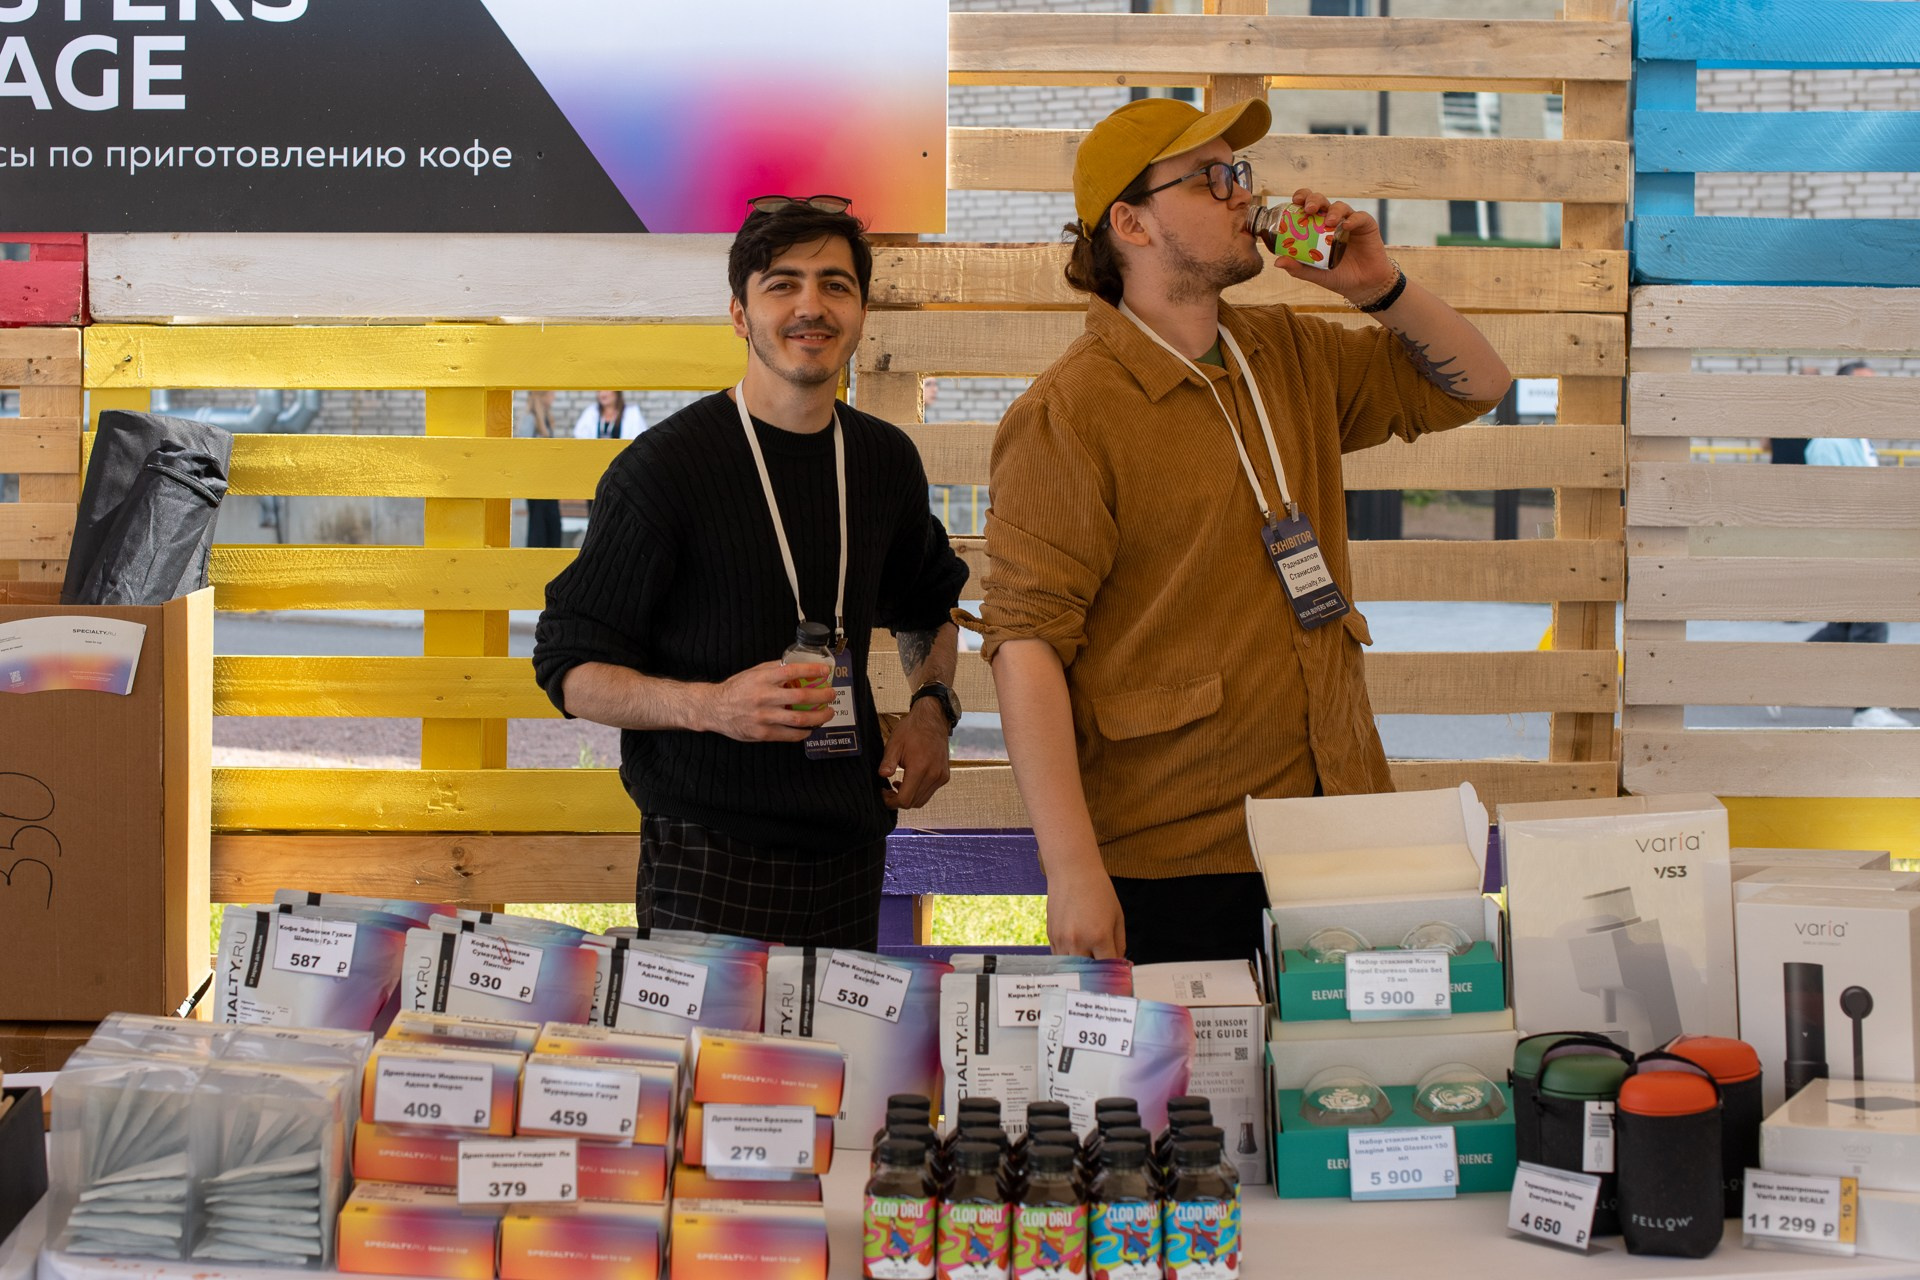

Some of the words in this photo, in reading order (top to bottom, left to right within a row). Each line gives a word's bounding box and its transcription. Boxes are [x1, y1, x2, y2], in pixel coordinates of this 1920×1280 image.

[50, 149, 94, 168] по
[106, 149, 406, 175] приготовлению
[421, 138, 512, 175] кофе
[1270, 530, 1313, 556] EXHIBITOR
[1289, 564, 1321, 581] Станислав
[806, 740, 820, 748] NEVA
[820, 738, 838, 747] BUYERS
[838, 737, 852, 745] WEEK
[1653, 865, 1687, 879] VS3
[280, 924, 297, 932] Кофе
[471, 940, 490, 949] Кофе
[290, 953, 320, 968] 587
[638, 961, 656, 970] Кофе
[831, 959, 850, 969] Кофе
[469, 972, 502, 990] 930
[638, 989, 670, 1007] 900
[837, 989, 869, 1008] 530
[1312, 989, 1345, 1001] ELEVAT
[1364, 991, 1375, 1005] 5
[1381, 990, 1415, 1005] 900
[1215, 1019, 1248, 1027] SENSORY
[1079, 1030, 1107, 1046] 930
[1217, 1029, 1248, 1039] GUIDE
[403, 1102, 442, 1118] 409
[549, 1110, 588, 1127] 459
[731, 1145, 766, 1161] 279
[1327, 1158, 1350, 1170] ELEV
[1370, 1172, 1382, 1186] 5
[1388, 1168, 1422, 1185] 900
[489, 1182, 527, 1197] 379
[1520, 1212, 1531, 1228] 4
[1534, 1215, 1562, 1235] 650
[1748, 1213, 1770, 1229] 11
[1778, 1215, 1815, 1233] 299
